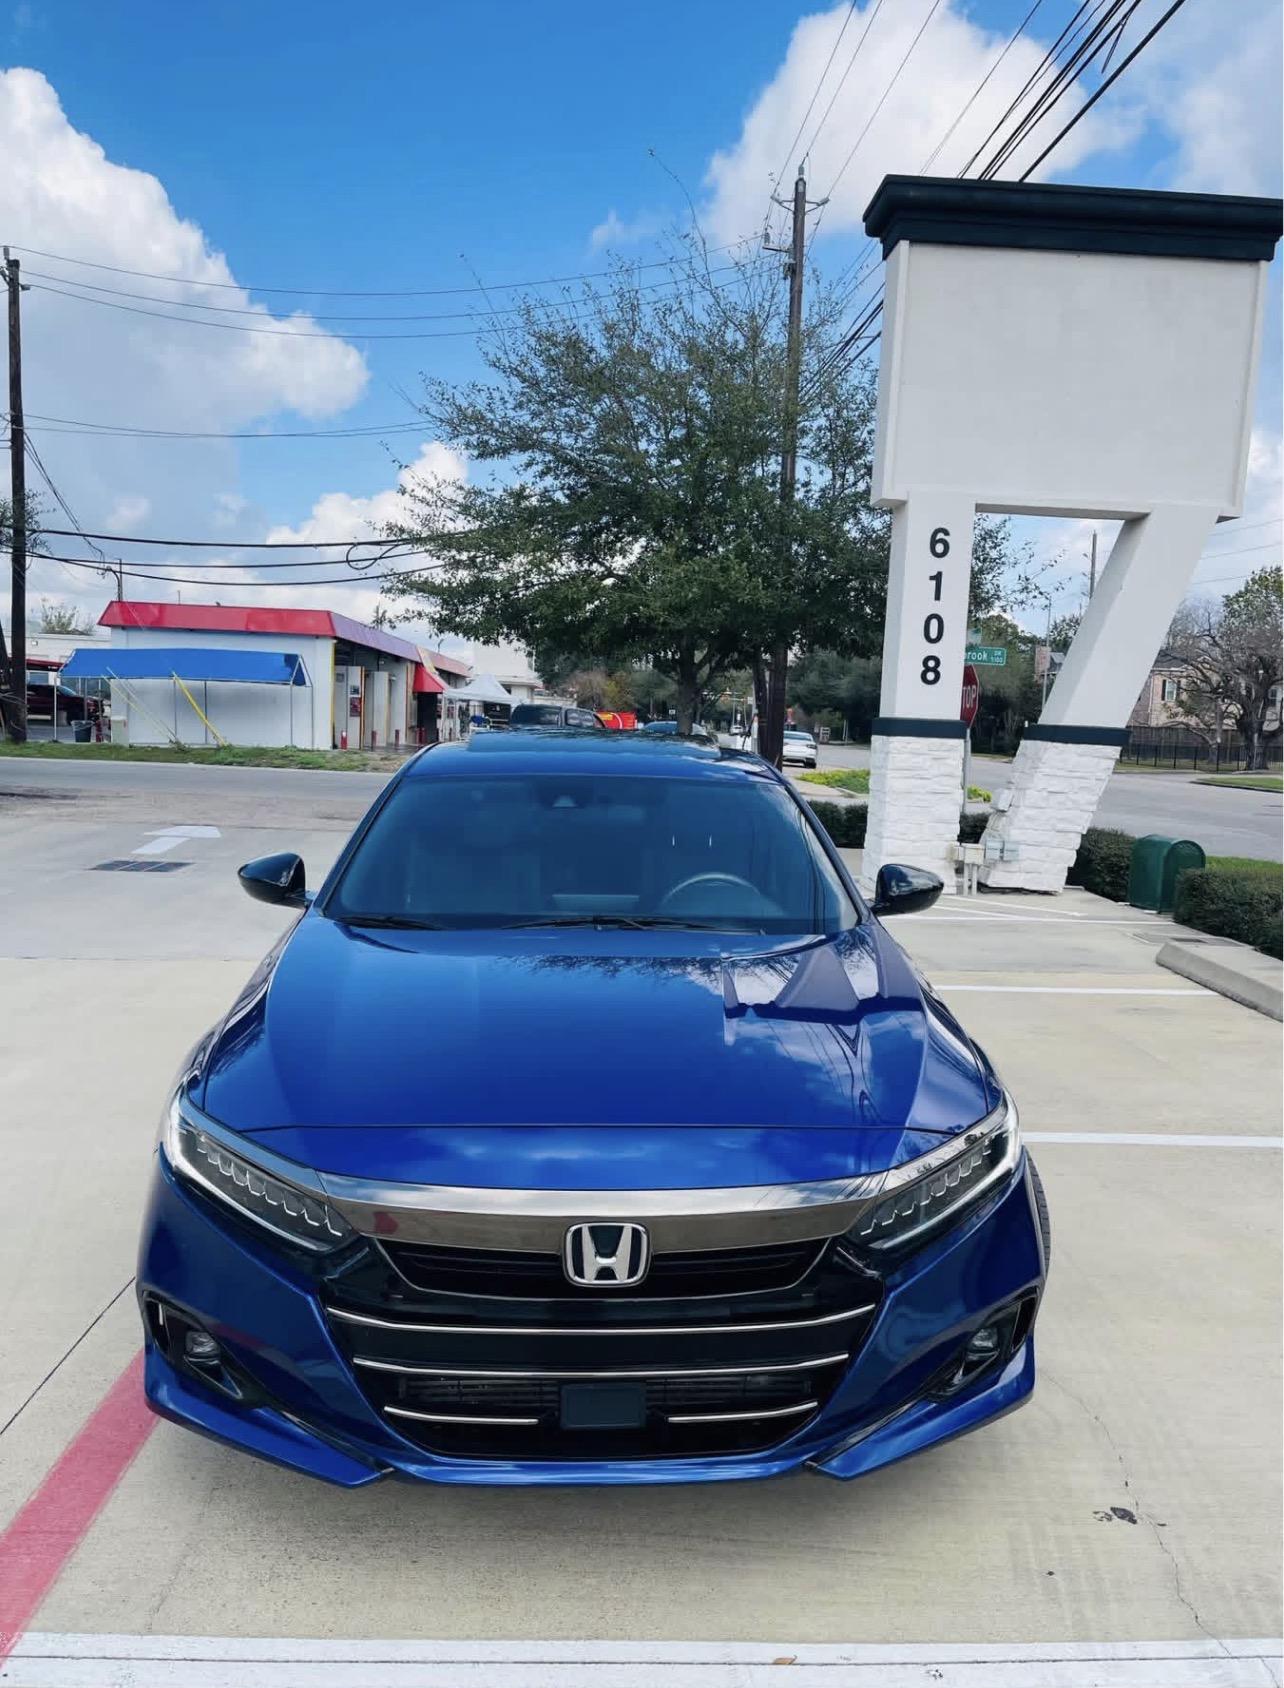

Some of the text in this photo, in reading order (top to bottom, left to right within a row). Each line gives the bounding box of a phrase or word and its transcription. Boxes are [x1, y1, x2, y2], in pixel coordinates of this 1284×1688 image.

[920, 527, 950, 685] 6108
[964, 650, 988, 661] rook
[962, 685, 977, 709] TOP
